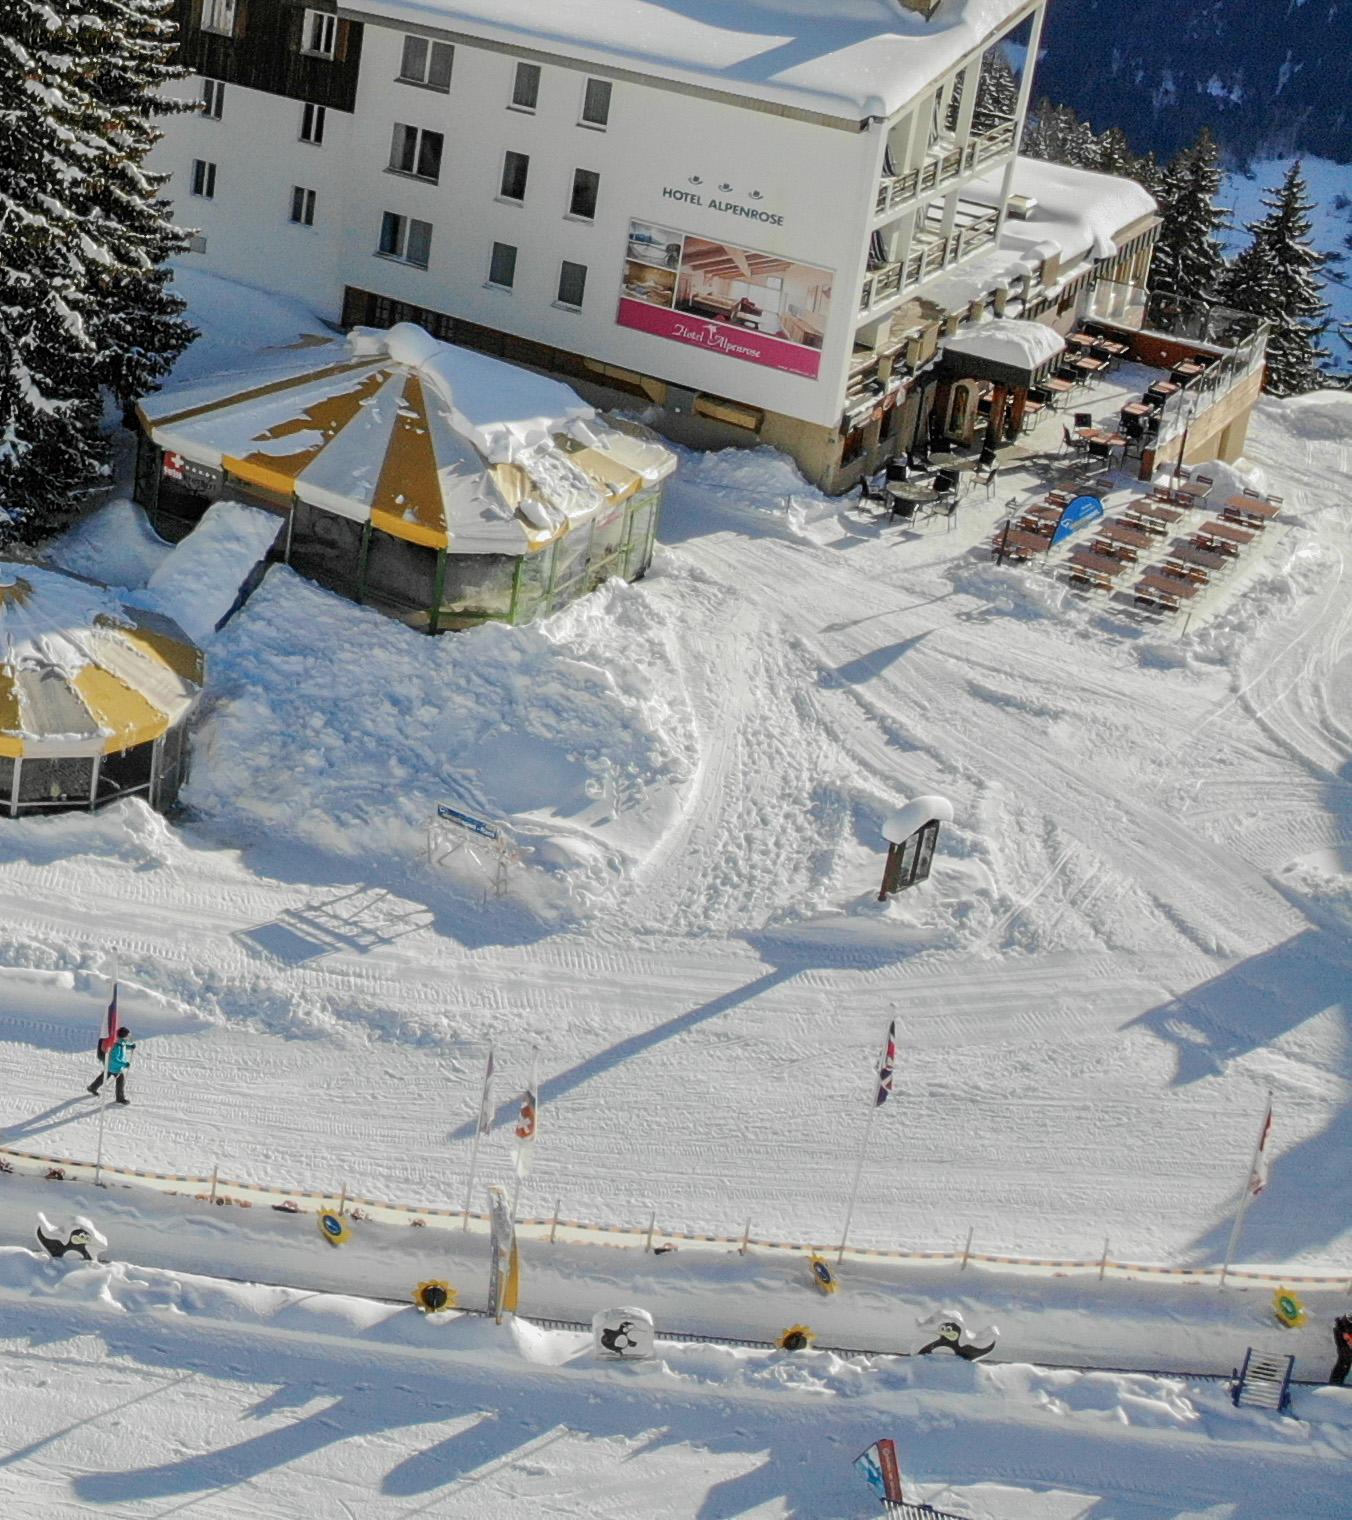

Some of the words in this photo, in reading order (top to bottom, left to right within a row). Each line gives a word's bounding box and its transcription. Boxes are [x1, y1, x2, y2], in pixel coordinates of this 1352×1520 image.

[662, 187, 703, 206] HOTEL
[707, 199, 785, 226] ALPENROSE
[672, 324, 704, 342] Hotel
[708, 335, 761, 358] Alpenrose
